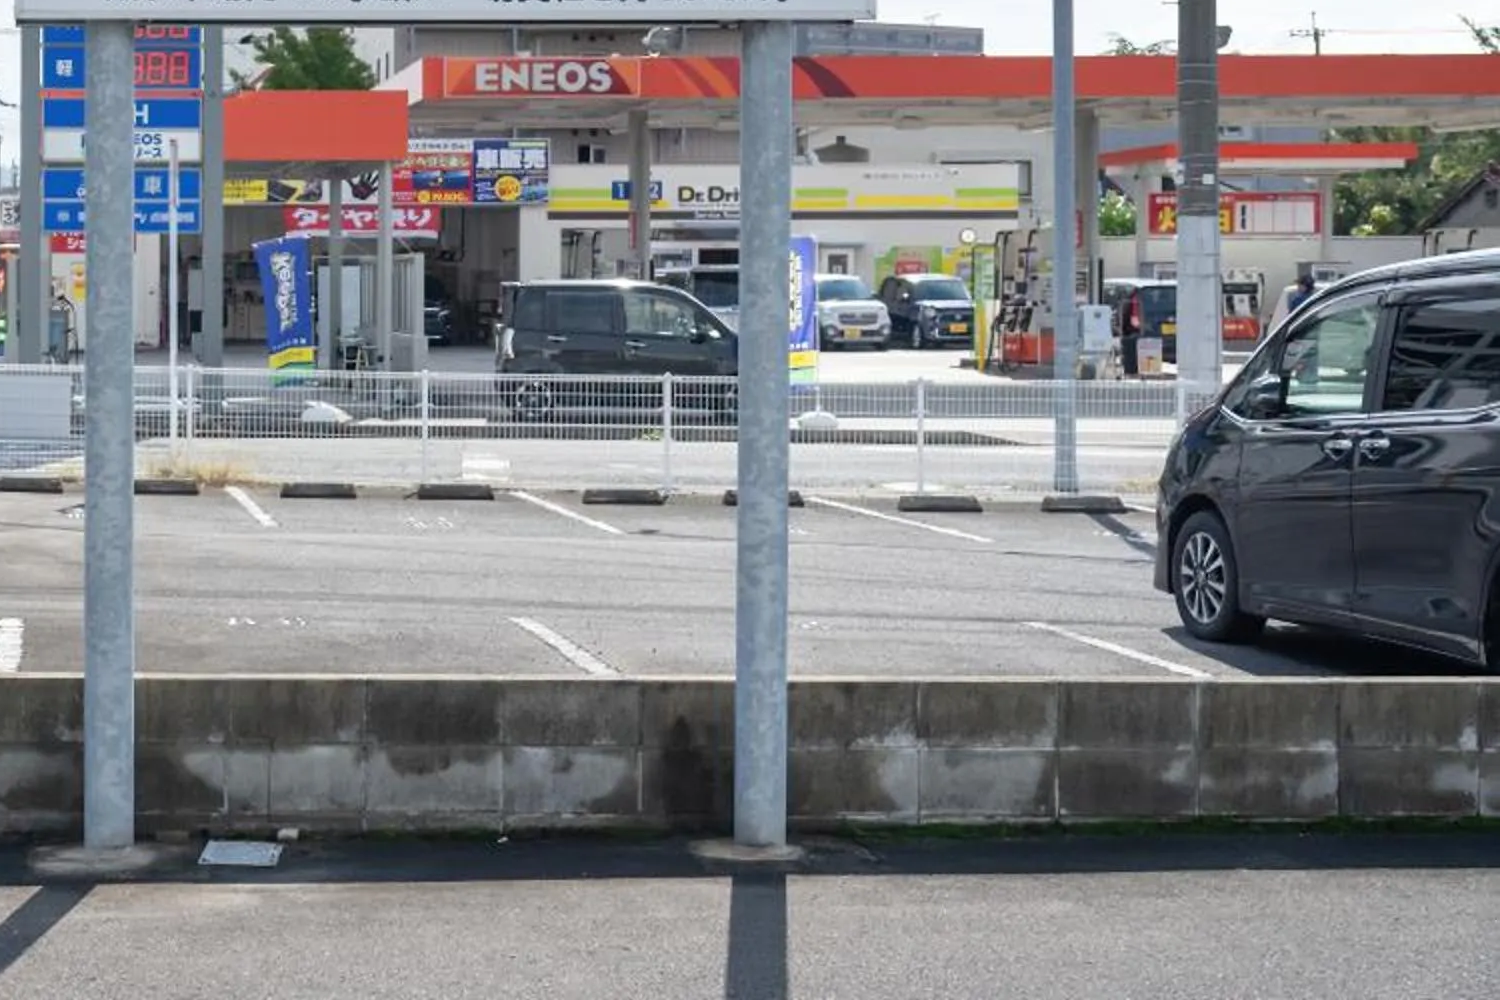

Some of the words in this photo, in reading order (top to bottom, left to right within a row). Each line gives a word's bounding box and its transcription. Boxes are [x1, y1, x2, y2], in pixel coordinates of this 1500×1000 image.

[475, 61, 613, 92] ENEOS
[134, 133, 163, 146] EOS
[475, 147, 547, 170] 車販売
[678, 185, 740, 203] Dr.Dri
